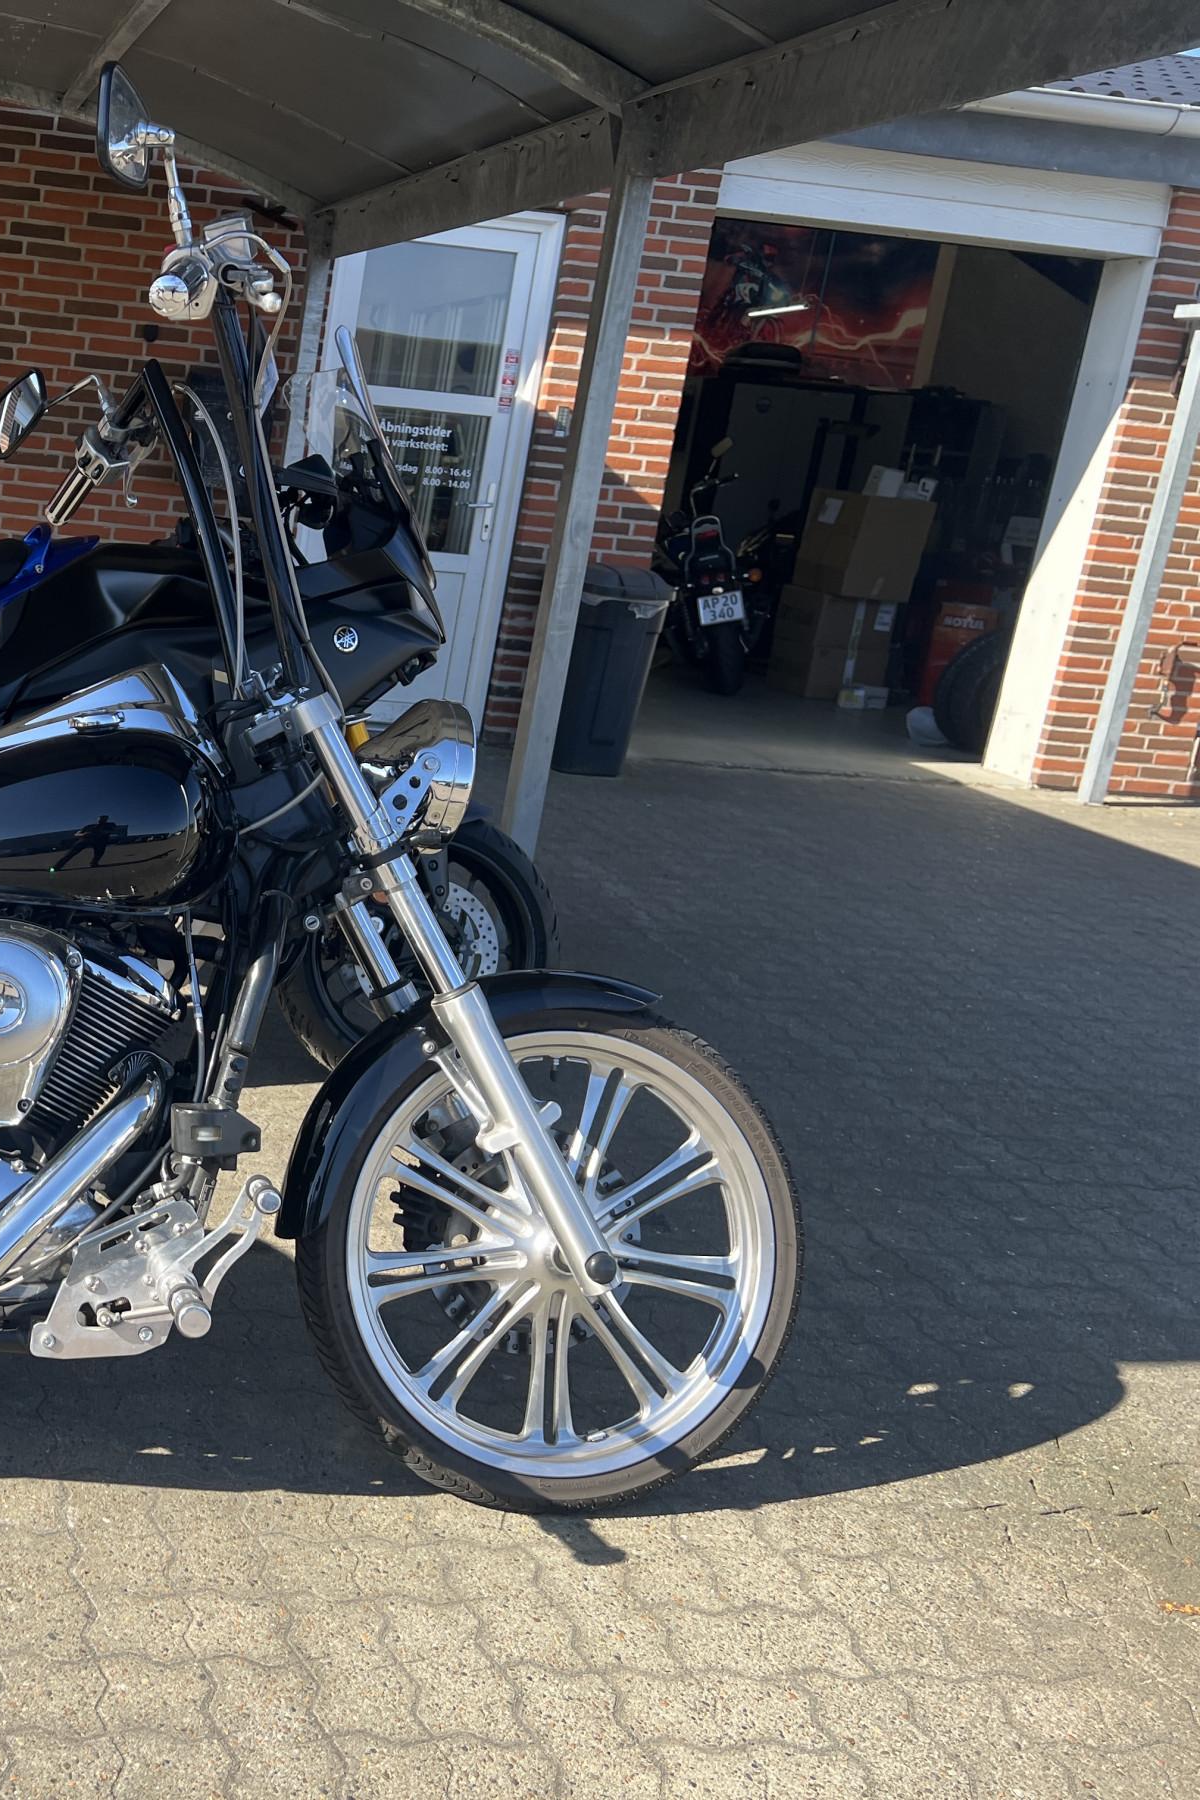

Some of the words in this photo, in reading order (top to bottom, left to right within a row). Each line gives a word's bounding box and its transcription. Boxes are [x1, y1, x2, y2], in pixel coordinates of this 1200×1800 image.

[379, 418, 452, 438] Åbningstider
[391, 438, 449, 452] værkstedet:
[424, 465, 443, 474] 8.00
[449, 467, 472, 477] 16.45
[422, 477, 441, 487] 8.00
[447, 479, 470, 489] 14.00
[709, 606, 735, 622] 340
